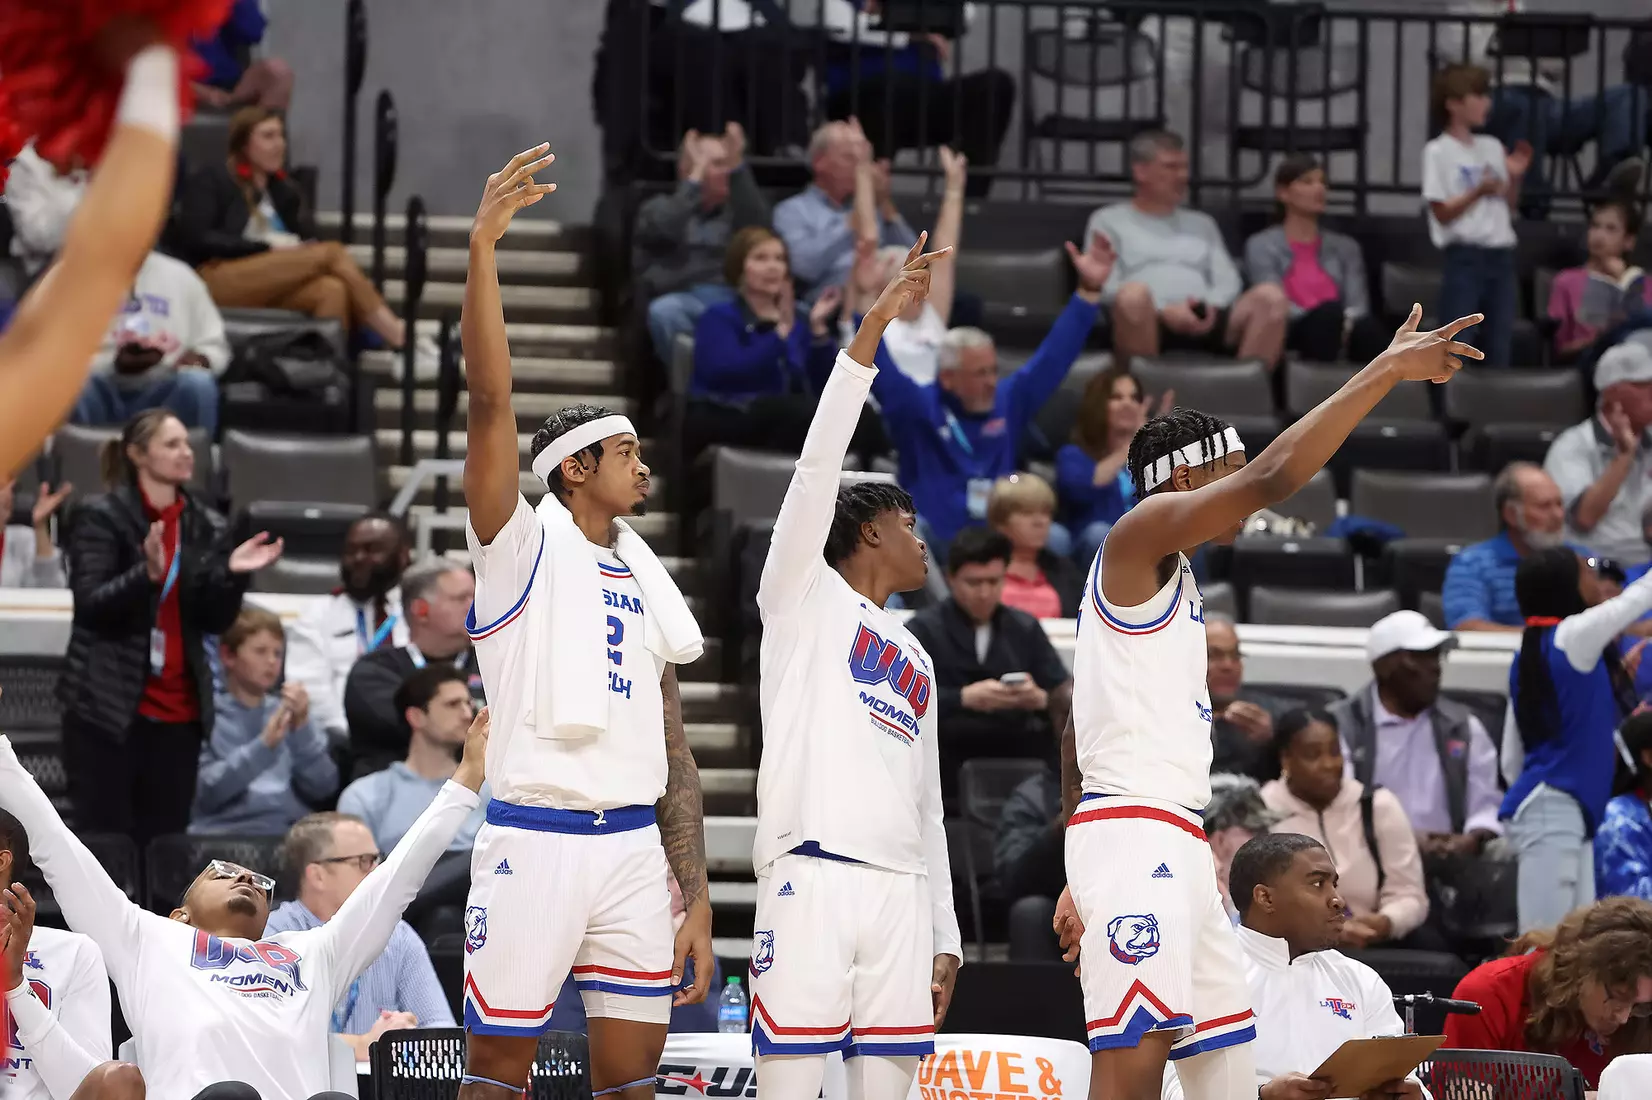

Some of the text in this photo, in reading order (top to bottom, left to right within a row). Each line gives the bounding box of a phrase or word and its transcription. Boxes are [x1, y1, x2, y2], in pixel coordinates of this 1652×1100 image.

[859, 691, 920, 736] MOMEN
[210, 973, 296, 997] MOMENT
[1035, 1057, 1063, 1096] &
